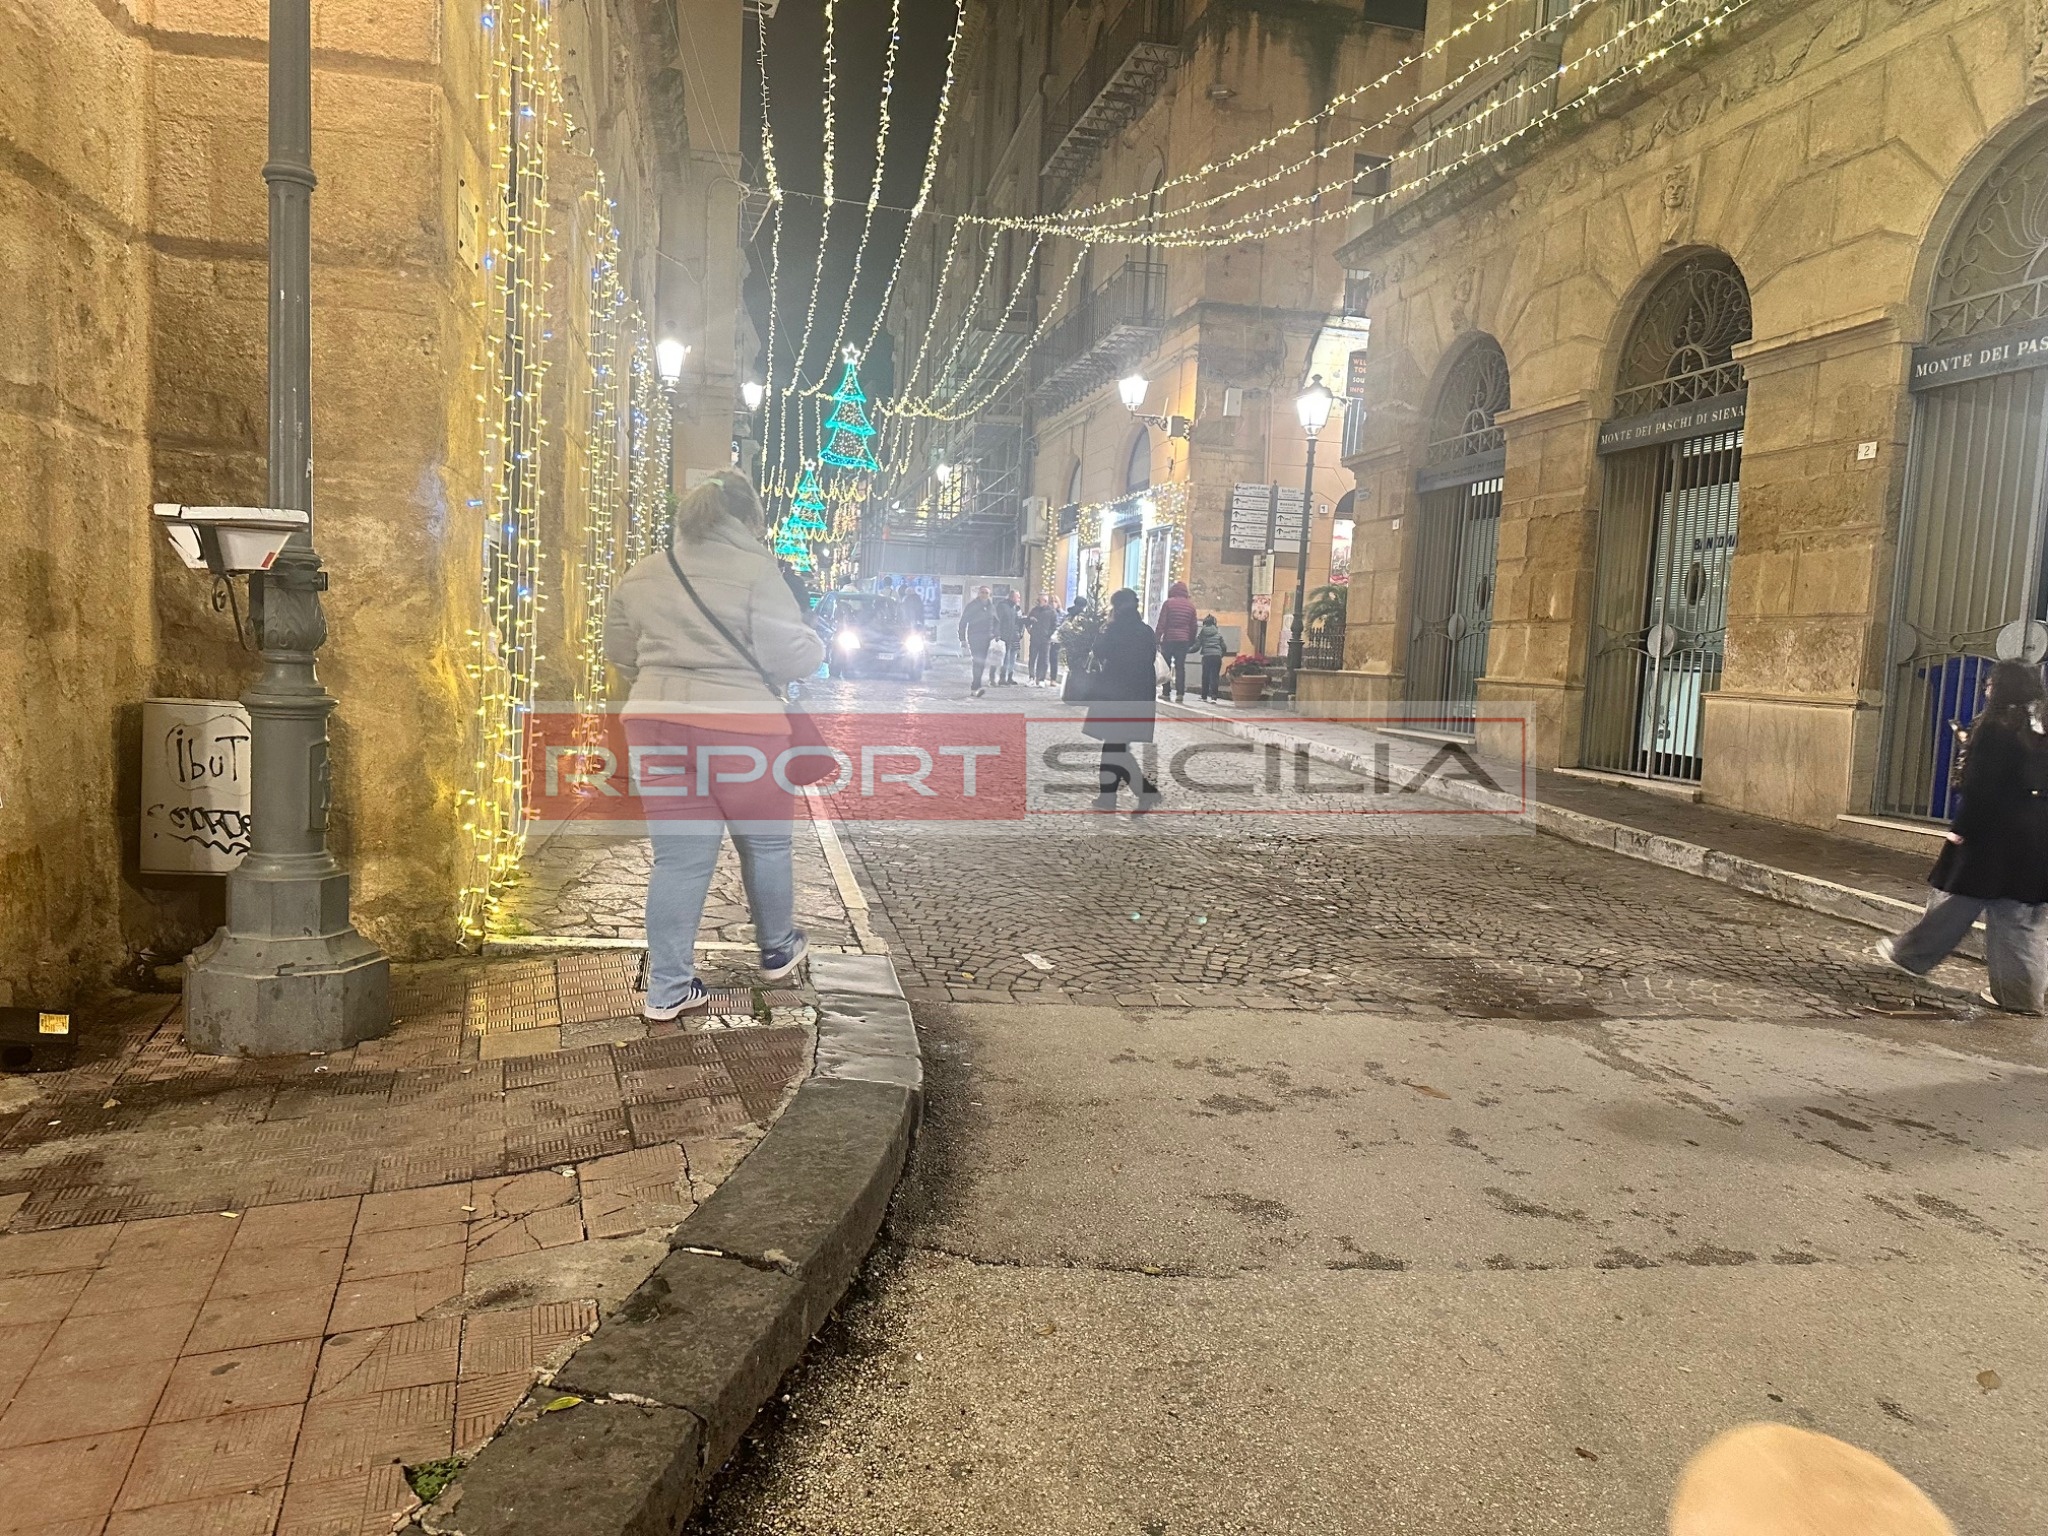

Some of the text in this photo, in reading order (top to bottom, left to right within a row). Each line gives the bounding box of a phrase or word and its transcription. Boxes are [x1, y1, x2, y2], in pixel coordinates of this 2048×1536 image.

[1915, 353, 1973, 378] MONTE
[1980, 345, 2010, 364] DEI
[1600, 404, 1745, 445] MONTE DEI PASCHI DI SIENA
[1864, 445, 1870, 457] 2
